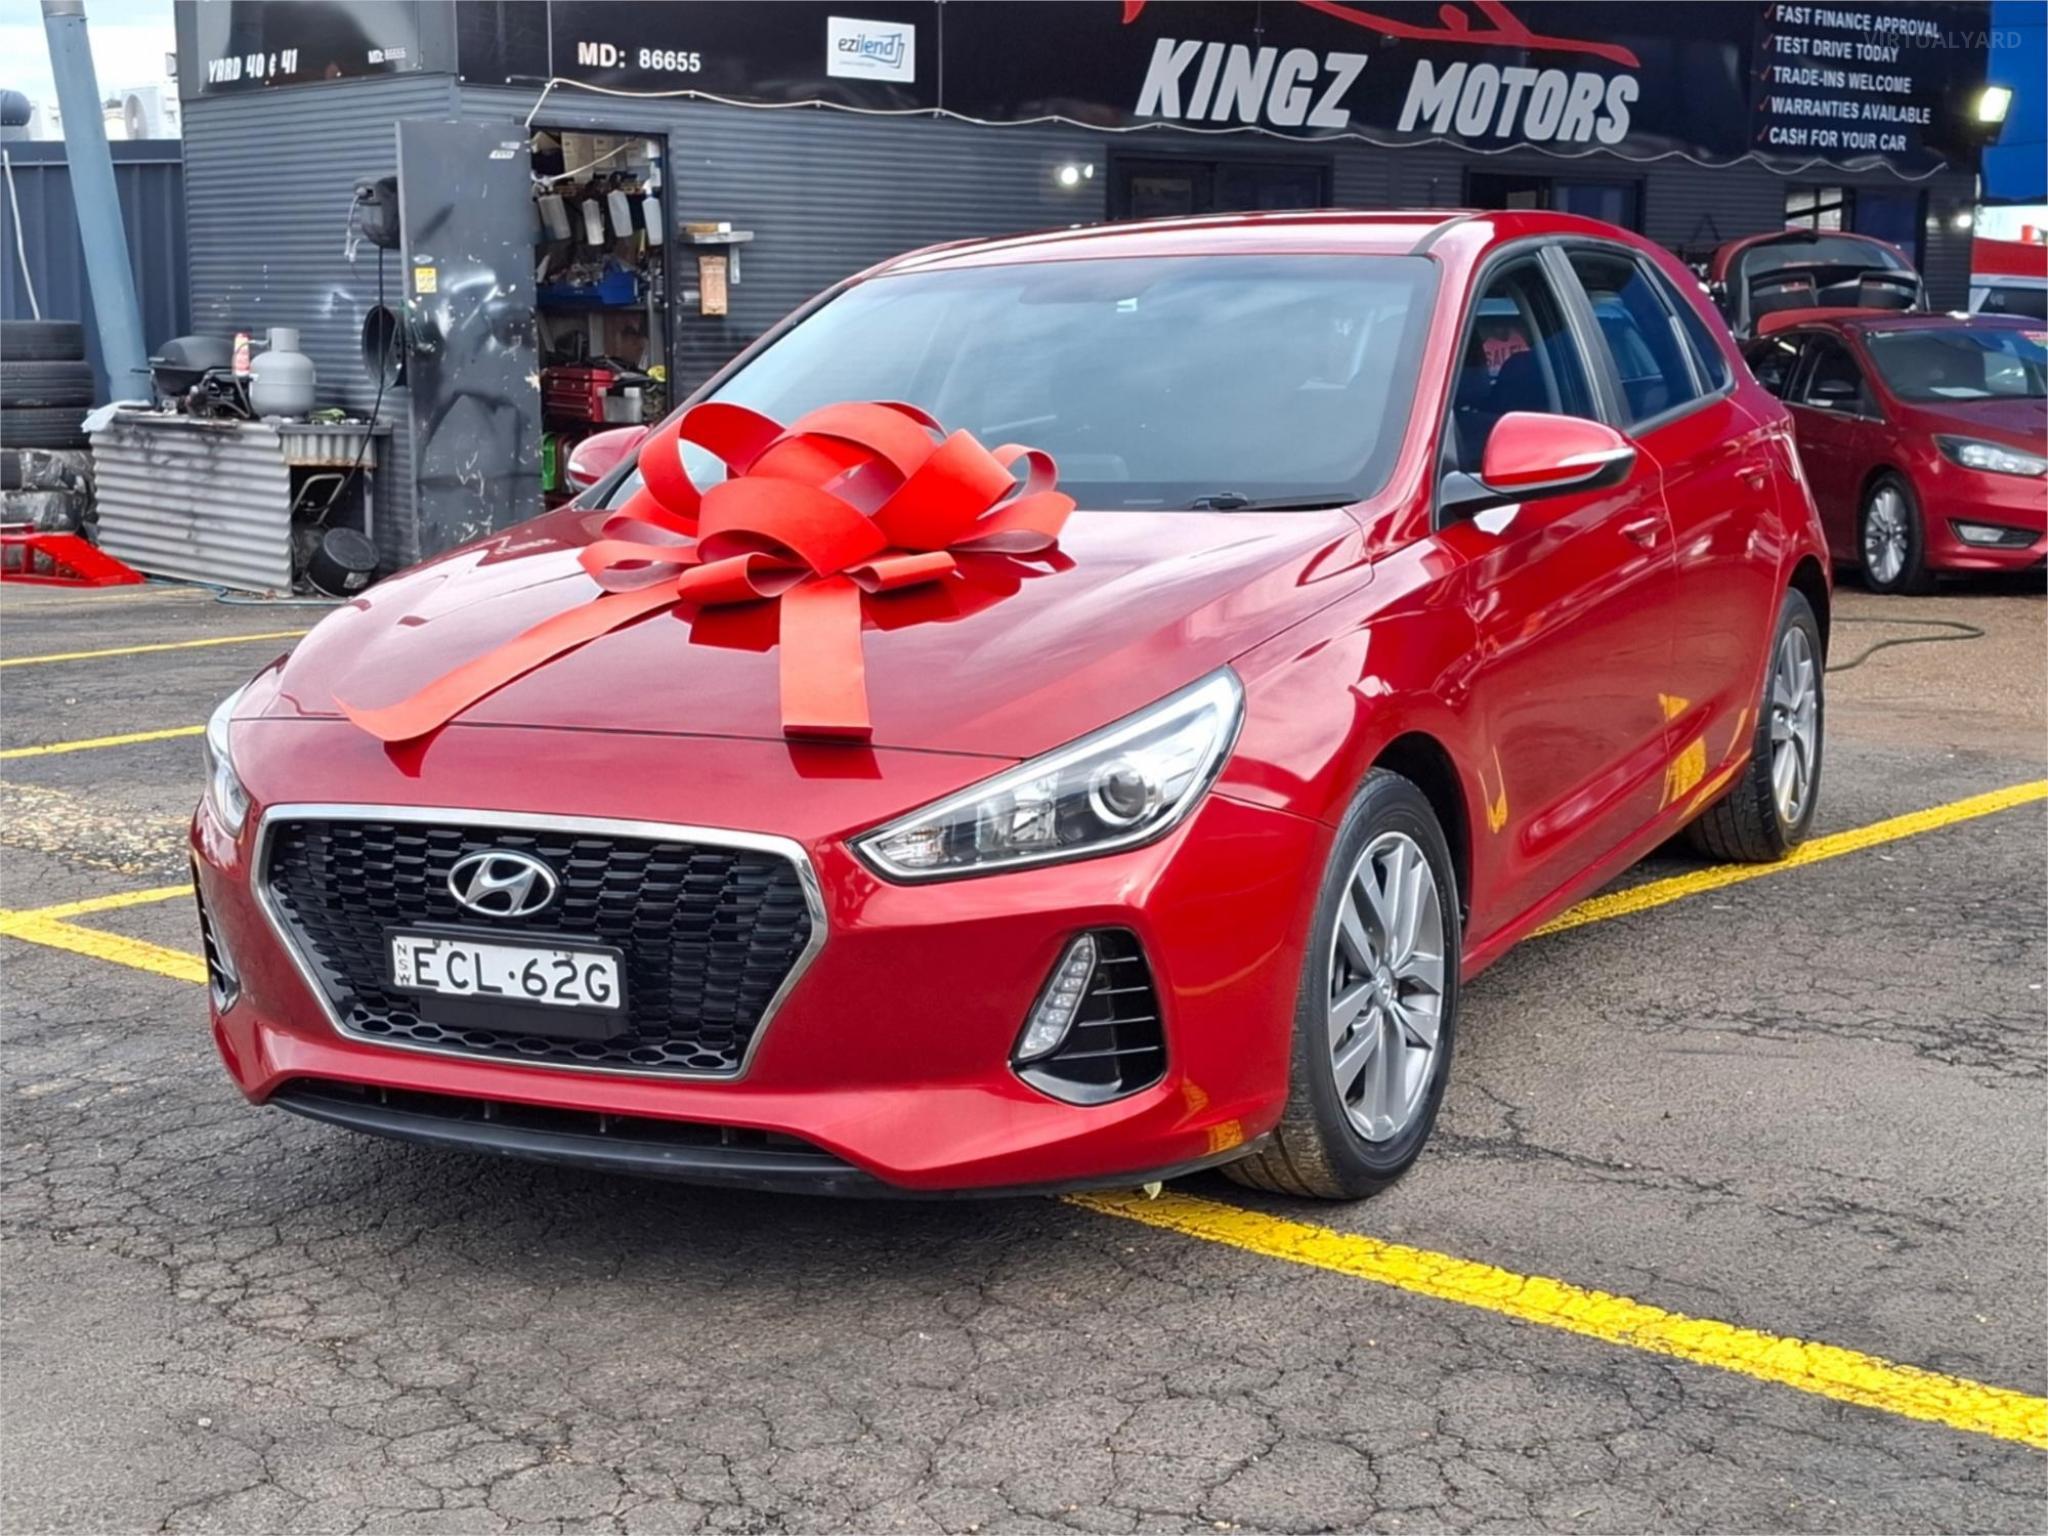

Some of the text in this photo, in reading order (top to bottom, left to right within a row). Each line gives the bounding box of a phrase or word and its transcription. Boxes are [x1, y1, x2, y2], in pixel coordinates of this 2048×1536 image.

[1776, 4, 1939, 39] FAST FINANCE APPROVAL
[578, 41, 701, 73] MD: 86655
[838, 33, 895, 55] ezilend
[1775, 35, 1899, 63] TEST DRIVE TODAY
[208, 56, 242, 83] YARD
[246, 52, 265, 78] 40
[281, 48, 298, 74] 41
[1134, 37, 1640, 145] KINGZ MOTORS
[1773, 66, 1912, 94] TRADE-INS WELCOME
[1771, 96, 1931, 124] WARRANTIES AVAILABLE
[1769, 127, 1907, 151] CASH FOR YOUR CAR
